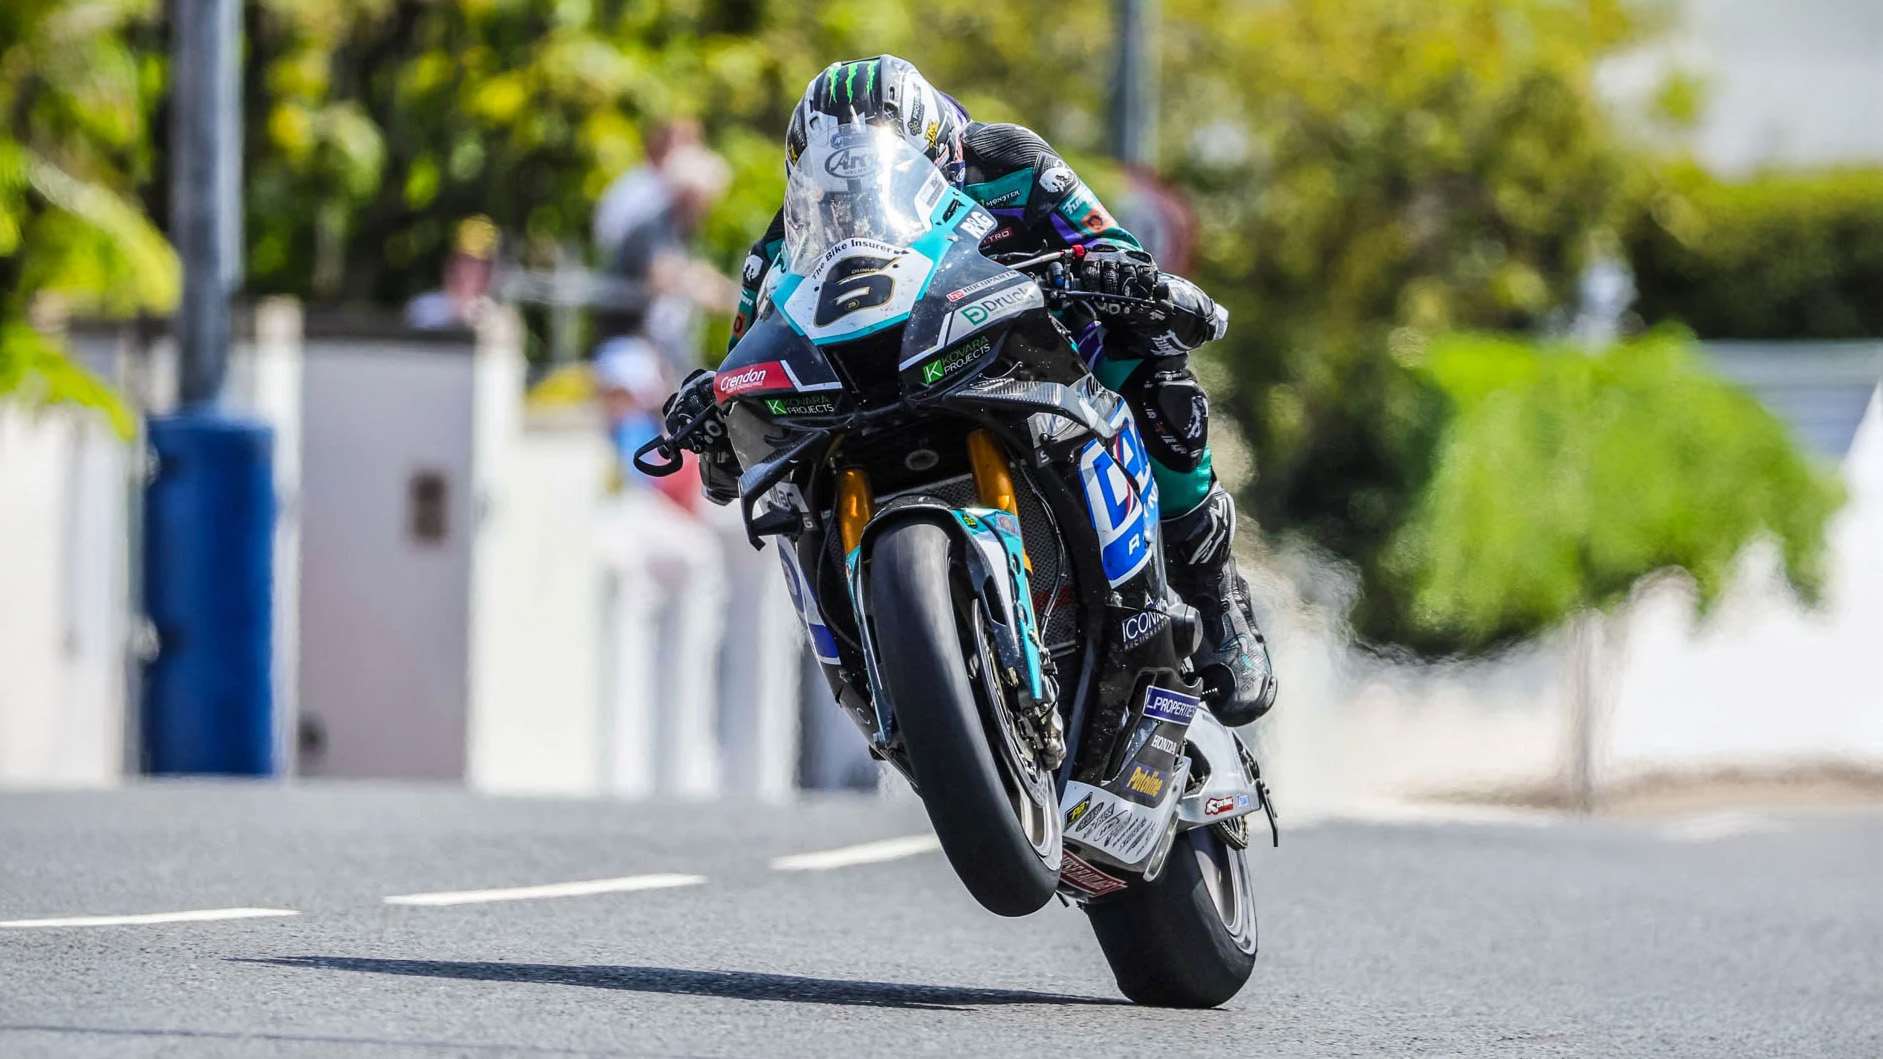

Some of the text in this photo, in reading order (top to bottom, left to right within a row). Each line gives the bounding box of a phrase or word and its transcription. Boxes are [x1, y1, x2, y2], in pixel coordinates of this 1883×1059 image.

[985, 190, 1021, 207] MONSTER
[812, 239, 891, 280] The Bike Insurer
[814, 256, 898, 327] 6
[942, 335, 989, 365] KOVARA
[944, 343, 991, 375] PROJECTS
[720, 367, 767, 391] Crendon
[787, 403, 835, 414] PROJECTS
[1151, 734, 1177, 755] HONDA
